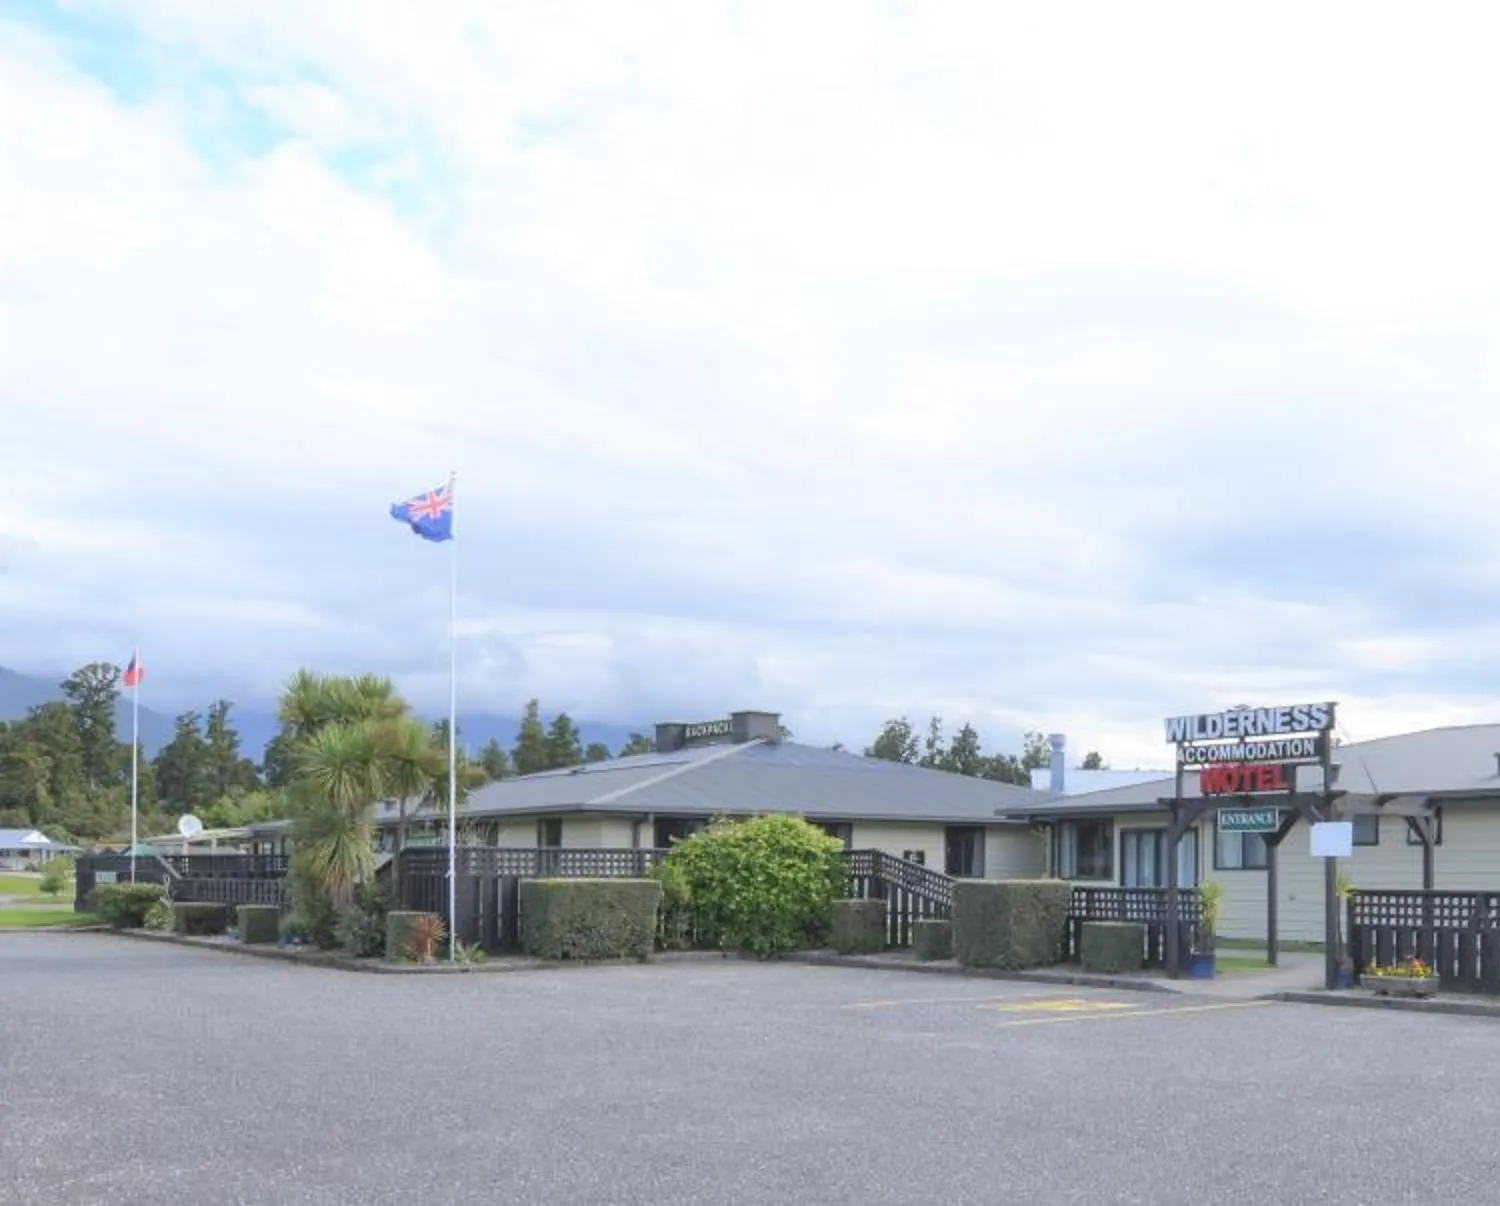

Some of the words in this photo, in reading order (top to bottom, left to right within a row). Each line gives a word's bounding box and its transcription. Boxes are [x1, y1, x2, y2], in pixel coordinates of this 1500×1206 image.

[1164, 703, 1330, 742] WILDERNESS
[1176, 739, 1316, 763] ACCOMMODATION
[1200, 764, 1289, 794] MOTEL
[1220, 811, 1275, 826] ENTRANCE
